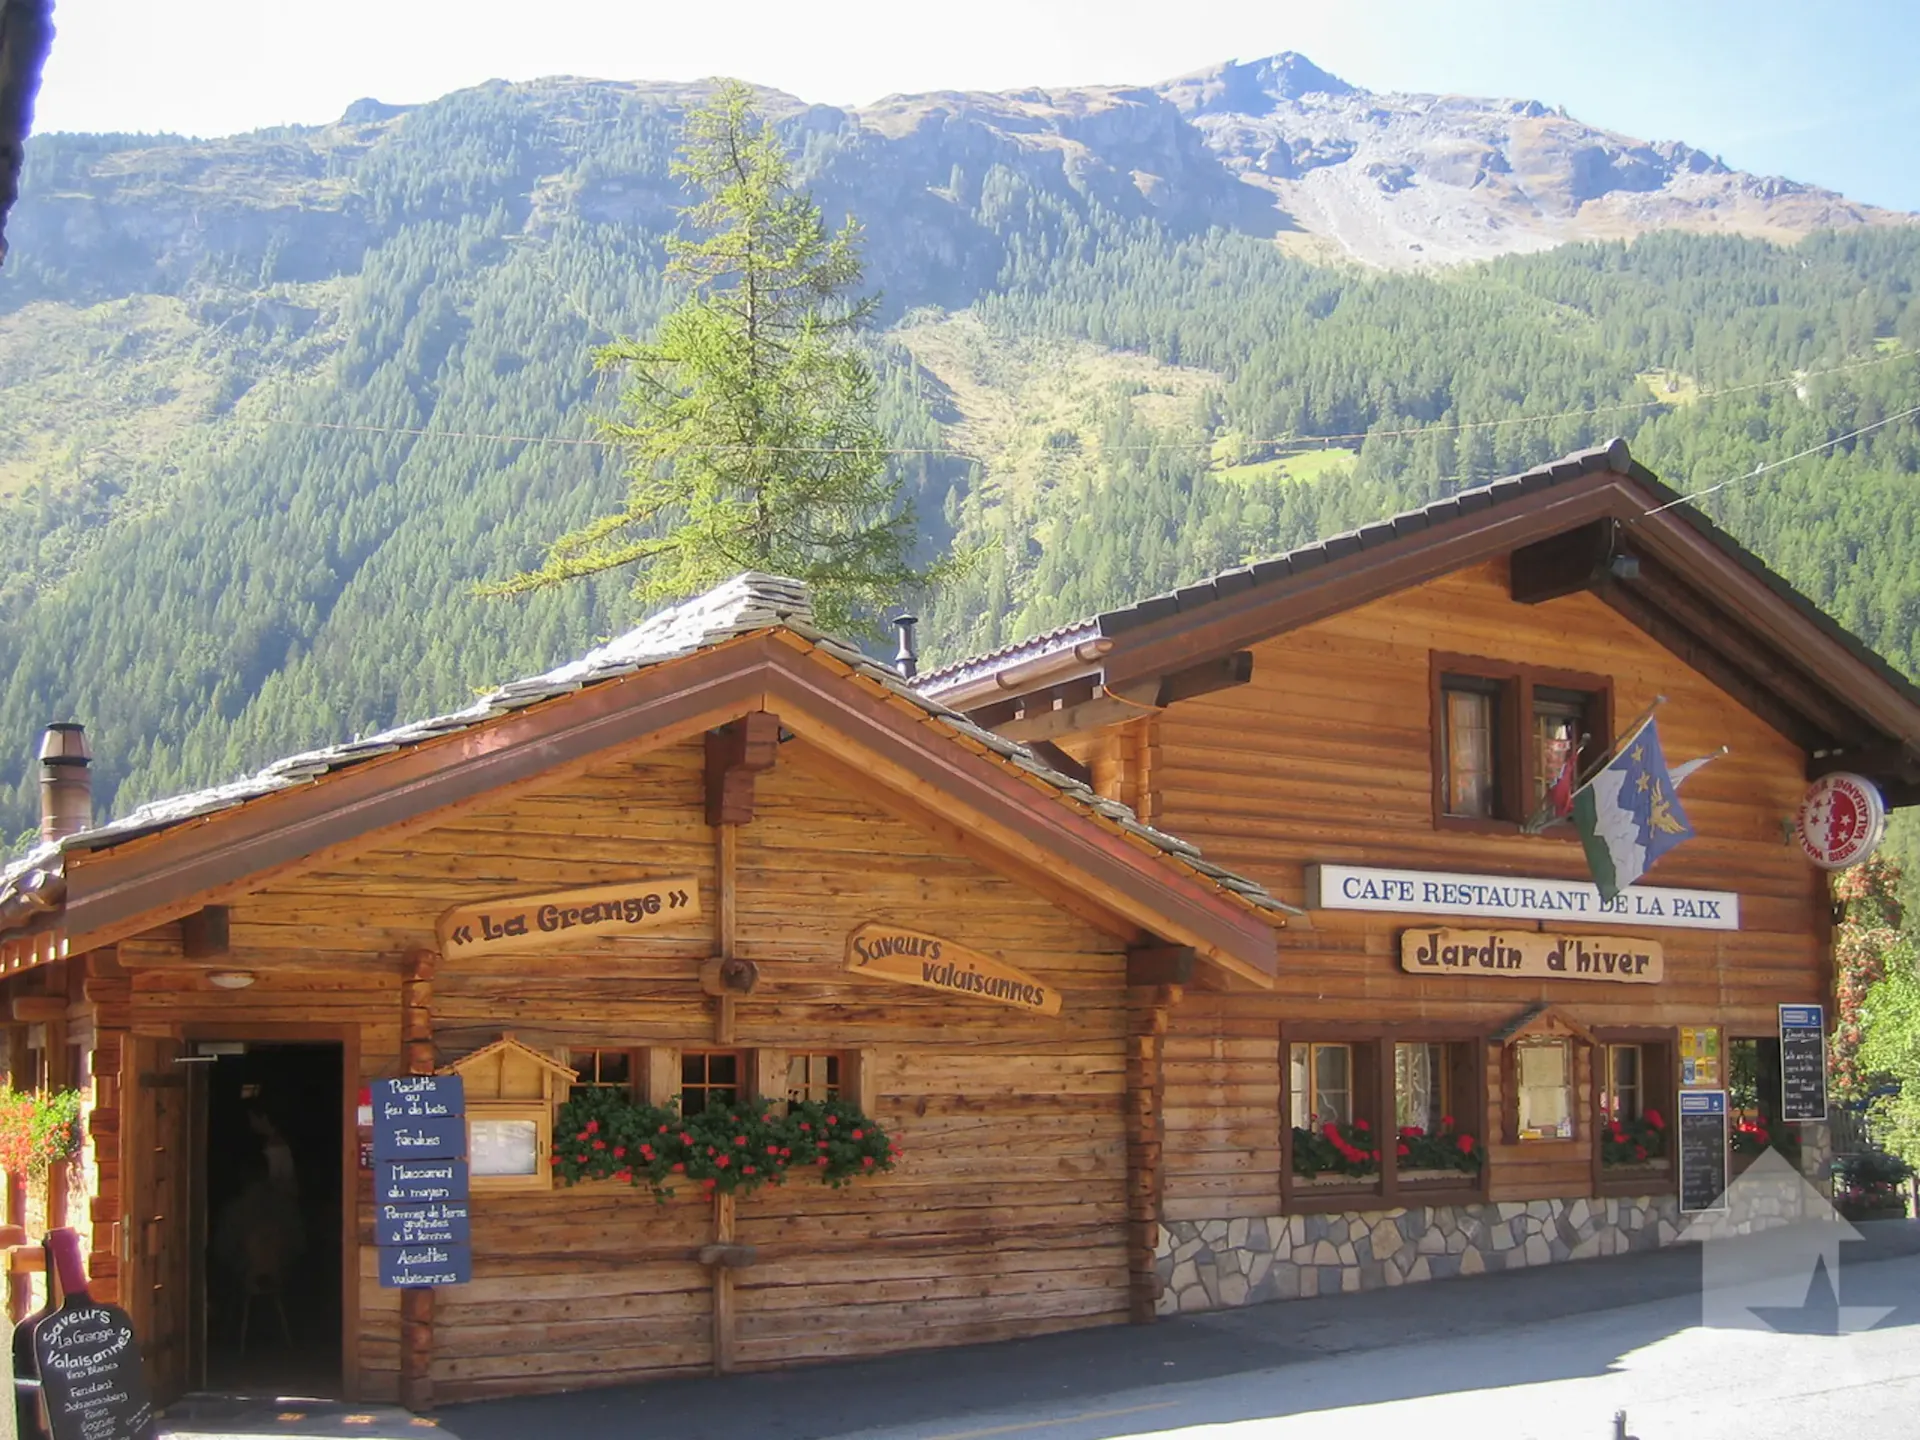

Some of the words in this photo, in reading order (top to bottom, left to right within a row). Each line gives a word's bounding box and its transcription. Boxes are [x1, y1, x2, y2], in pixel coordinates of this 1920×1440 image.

[1342, 877, 1414, 901] CAFE
[1422, 881, 1590, 911] RESTAURANT
[1599, 894, 1628, 914] DE
[1635, 896, 1665, 917] LA
[1672, 899, 1721, 919] PAIX
[536, 893, 662, 932] Grange
[853, 936, 942, 967] Saveurs
[1417, 933, 1522, 969] Jardin
[1547, 940, 1650, 974] d'hiver
[922, 962, 1045, 1006] valaisannes
[388, 1077, 436, 1094] Raclette
[405, 1094, 421, 1102] au
[384, 1102, 403, 1119] feu
[407, 1102, 423, 1115] de
[425, 1101, 448, 1115] bois
[394, 1129, 441, 1147] Fondues
[387, 1184, 405, 1198] du
[410, 1188, 450, 1201] mayen
[383, 1205, 426, 1219] Pommes
[427, 1204, 439, 1218] de
[442, 1204, 467, 1218] terre
[417, 1229, 452, 1241] tomme
[397, 1247, 448, 1265] Assiettes
[43, 1309, 111, 1345] Saveurs
[47, 1327, 132, 1369] Valaisannes
[70, 1380, 114, 1398] Fendant
